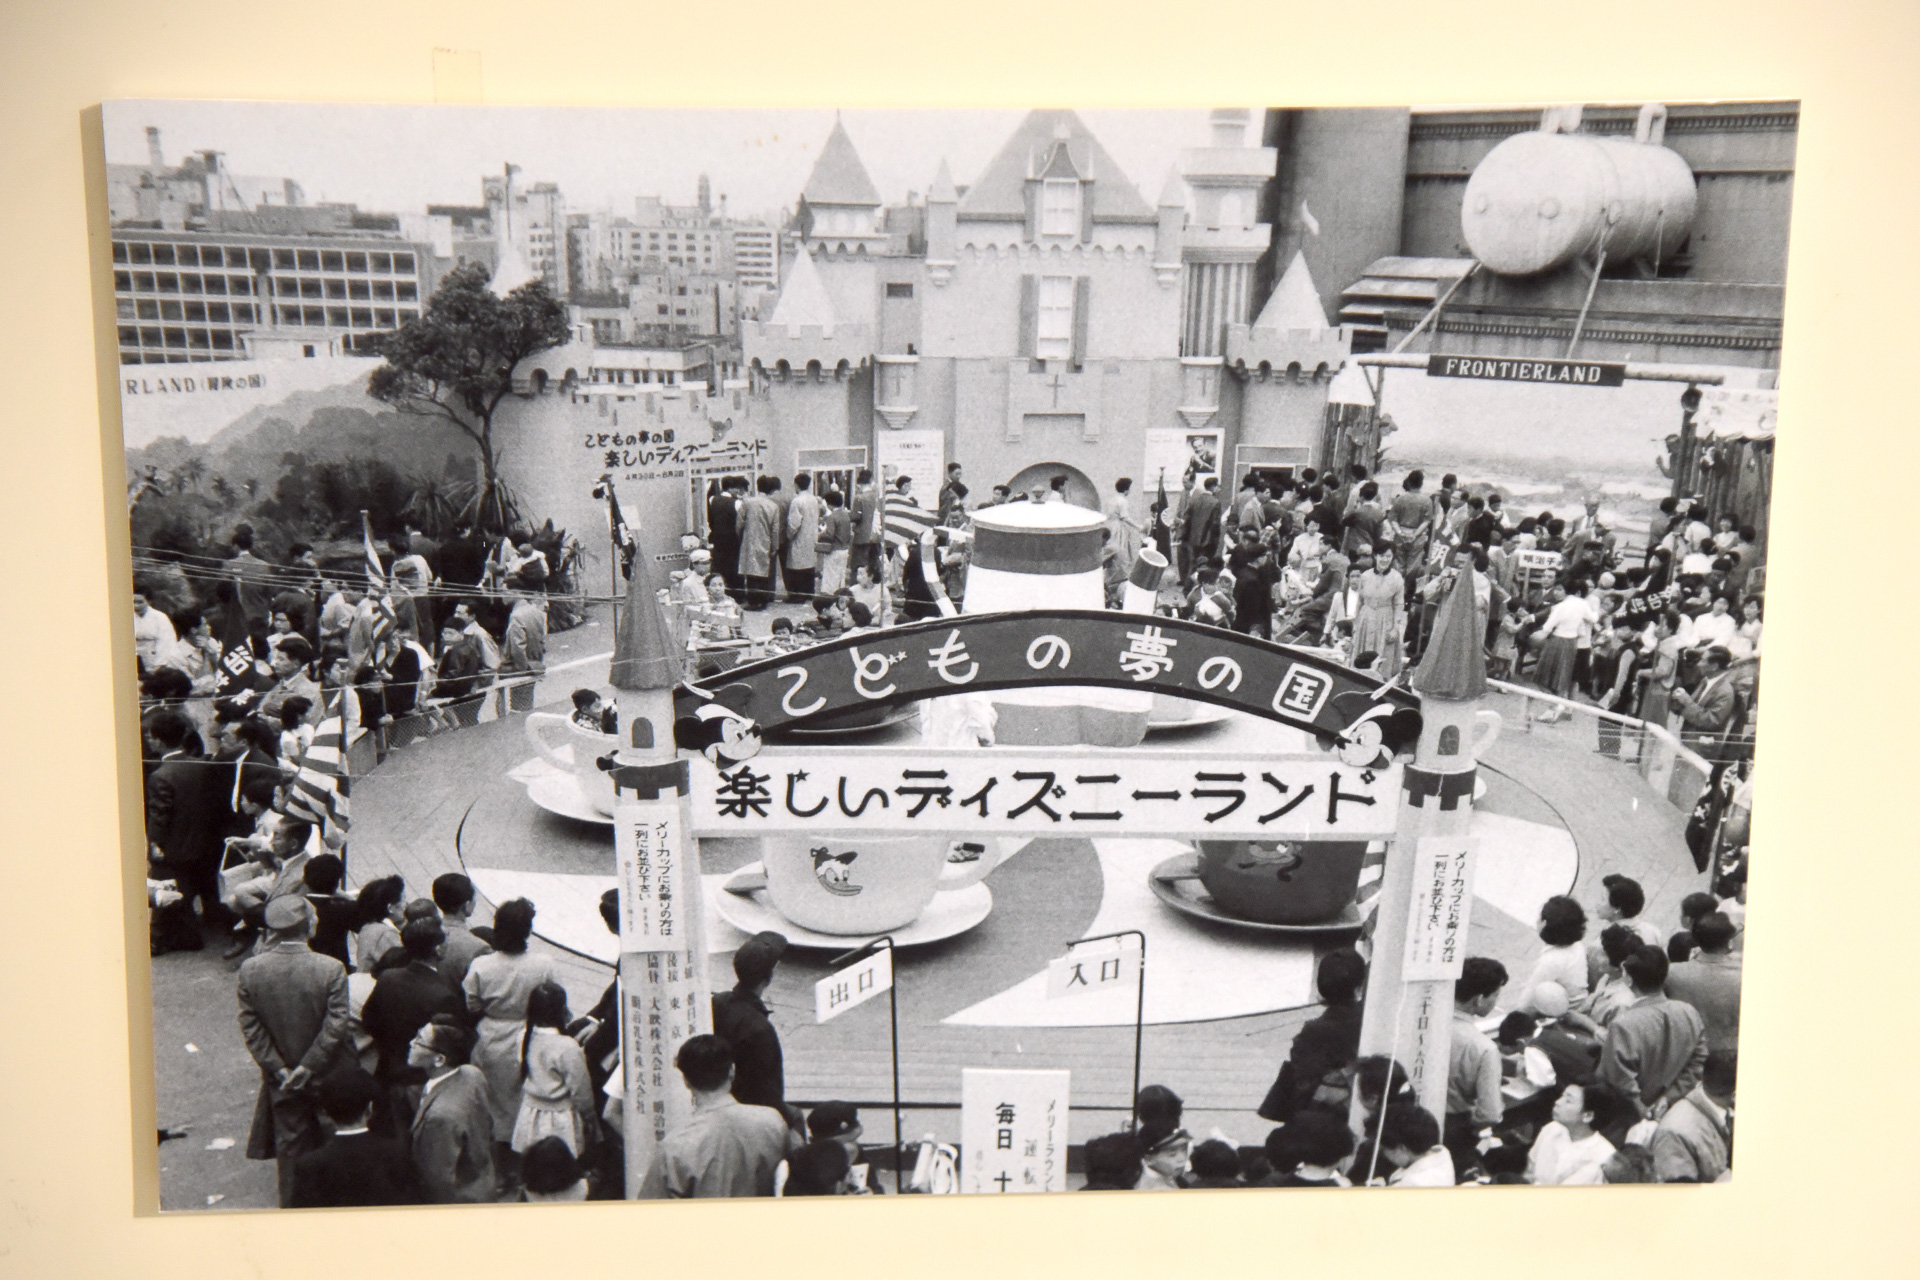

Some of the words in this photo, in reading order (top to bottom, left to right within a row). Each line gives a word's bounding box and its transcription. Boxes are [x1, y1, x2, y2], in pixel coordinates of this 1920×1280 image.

[1446, 359, 1602, 384] FRONTIERLAND
[777, 624, 1334, 723] こどもの夢の国
[830, 968, 874, 1008] 出口
[1066, 957, 1120, 989] 入口
